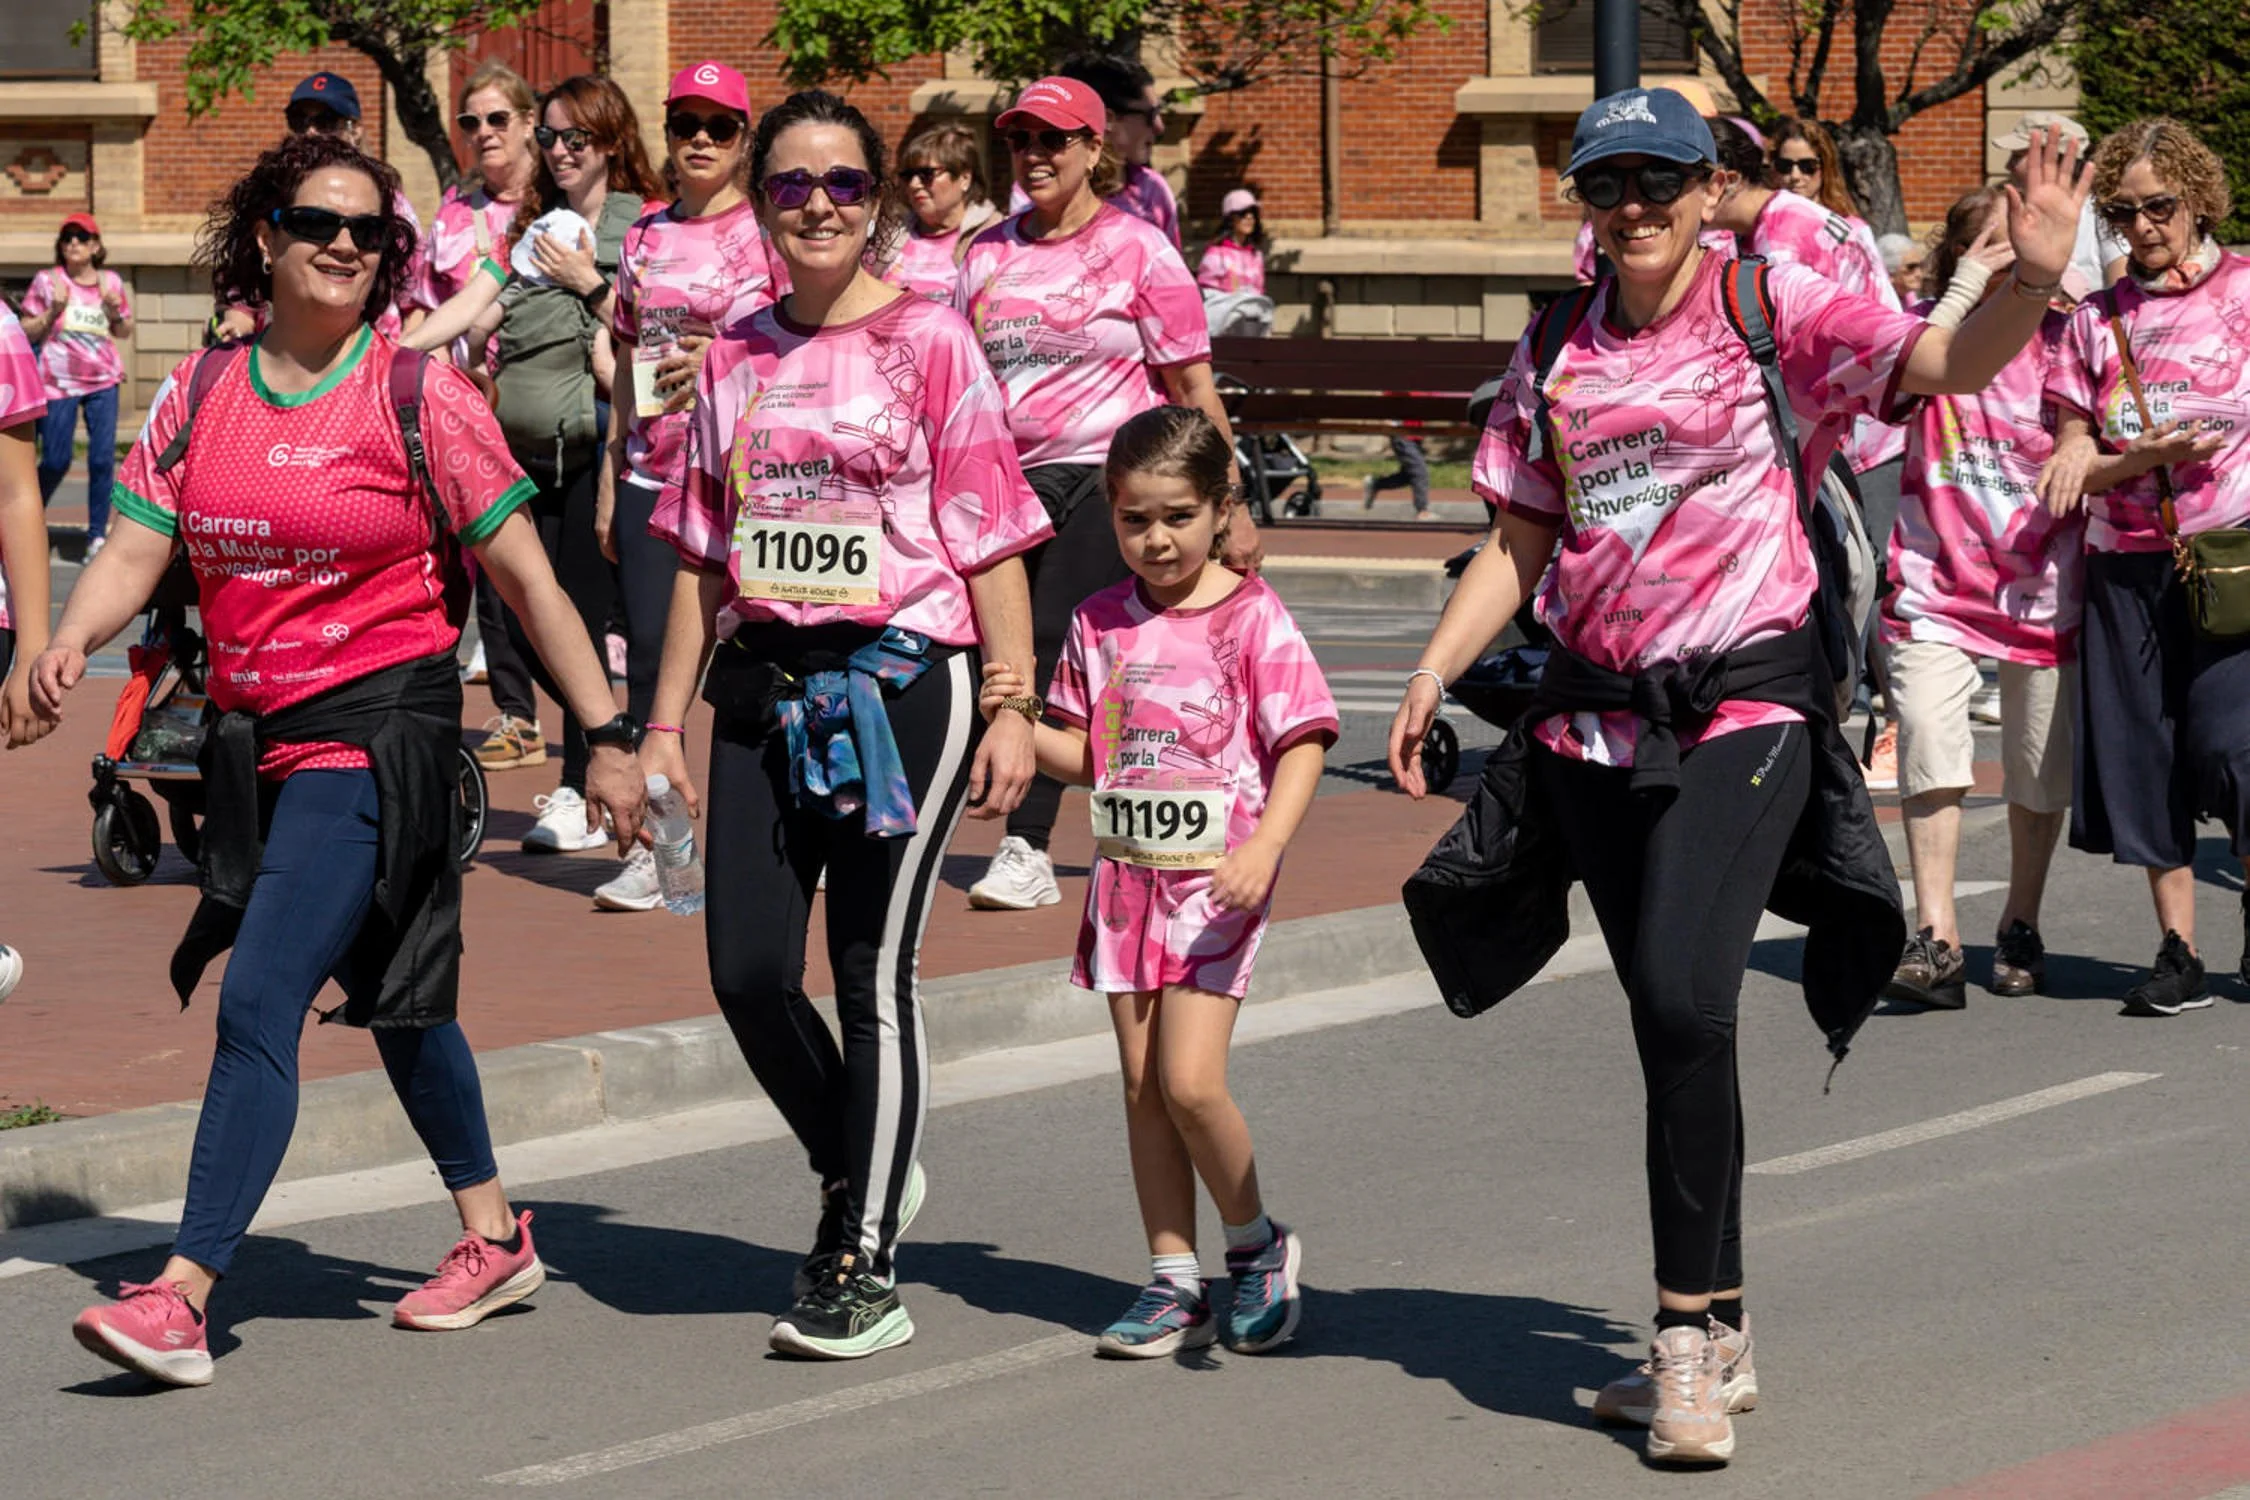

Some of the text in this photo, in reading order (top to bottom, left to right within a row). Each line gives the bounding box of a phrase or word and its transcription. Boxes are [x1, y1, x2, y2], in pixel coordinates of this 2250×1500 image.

[312, 76, 328, 91] C
[640, 304, 688, 319] Carrera
[983, 314, 1040, 333] Carrera
[983, 334, 1023, 354] por la
[2126, 379, 2189, 394] arrera
[2153, 398, 2169, 413] la
[1567, 407, 1588, 432] XI
[749, 429, 771, 451] XI
[1568, 427, 1665, 462] Carrera
[749, 457, 831, 481] Carrera
[1982, 453, 1997, 470] la
[1578, 459, 1649, 496] por la
[1585, 469, 1728, 521] Investigaón
[188, 510, 271, 536] Carrera
[218, 538, 286, 561] Mujer
[293, 547, 340, 566] por
[752, 529, 868, 576] 11096
[1119, 724, 1177, 745] Carrera
[1120, 747, 1155, 770] por la
[1103, 797, 1208, 841] 11199
